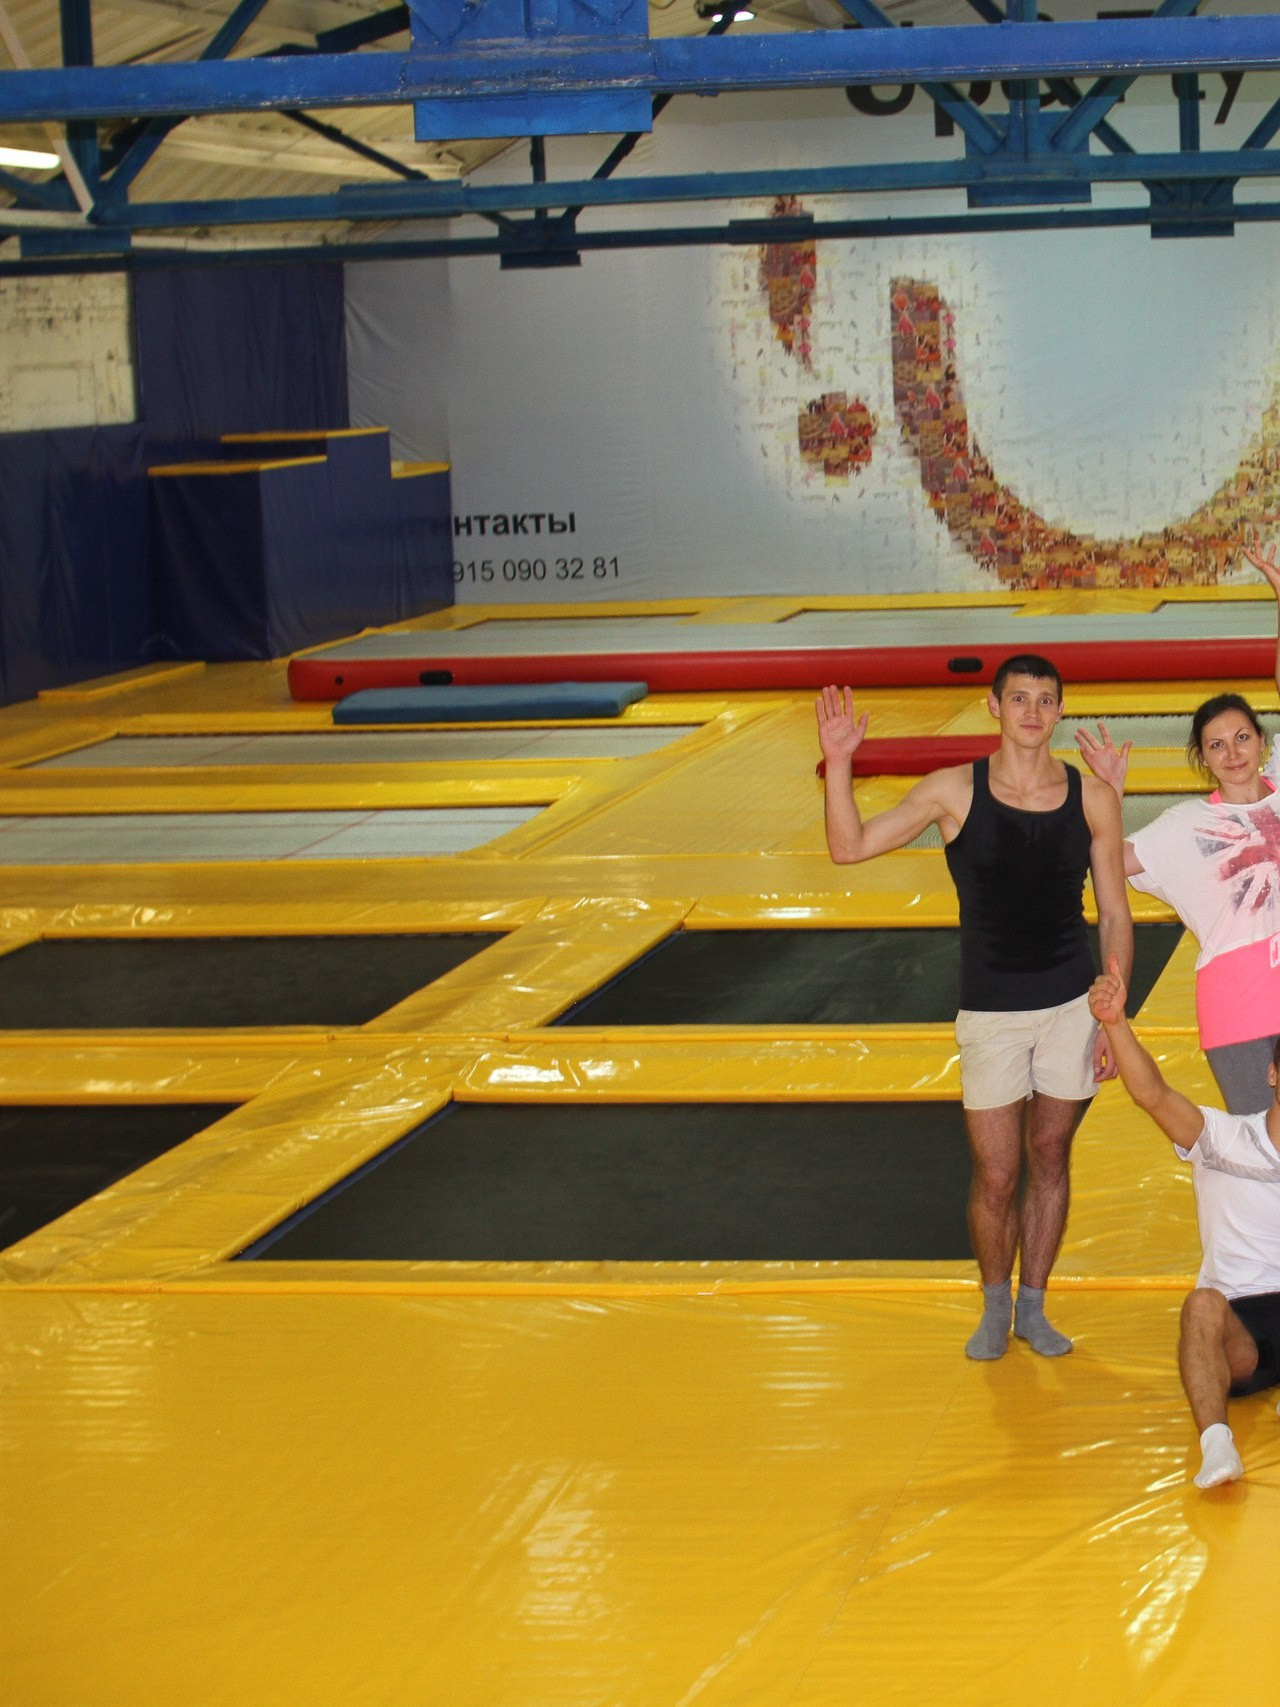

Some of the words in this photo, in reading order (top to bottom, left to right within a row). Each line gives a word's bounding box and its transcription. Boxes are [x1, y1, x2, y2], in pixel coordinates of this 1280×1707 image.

[454, 560, 495, 583] 915
[502, 558, 547, 582] 090
[555, 556, 585, 581] 32
[592, 555, 619, 579] 81
